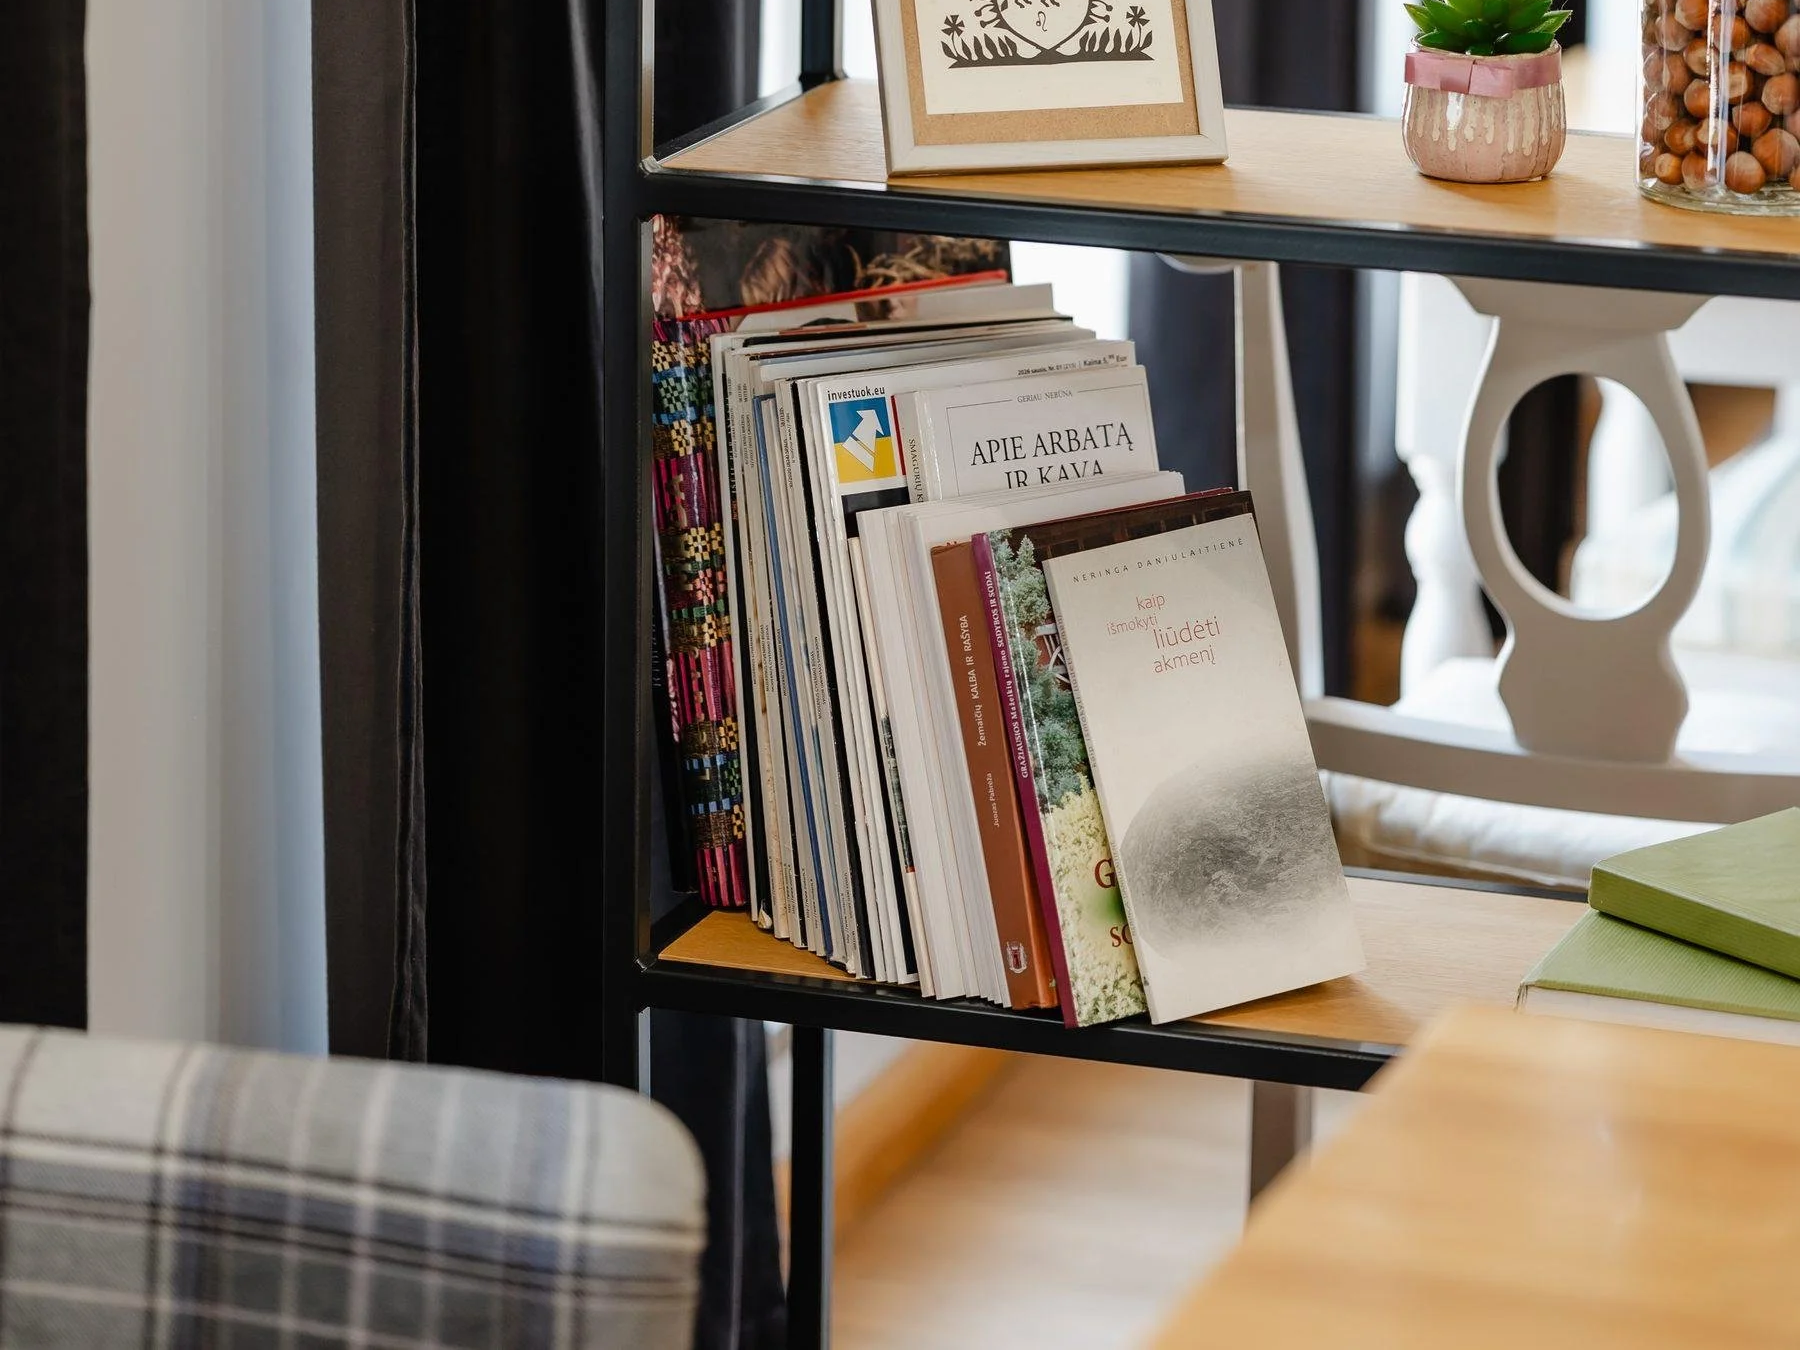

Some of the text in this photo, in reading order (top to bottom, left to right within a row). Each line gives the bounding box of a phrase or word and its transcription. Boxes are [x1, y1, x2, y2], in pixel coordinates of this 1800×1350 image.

[827, 386, 885, 401] investuok.eu
[970, 422, 1134, 466] APIE ARBATĄ
[1005, 469, 1028, 489] IR
[1073, 538, 1245, 583] NERINGA DANIULAITIENĖ
[985, 571, 995, 598] SODAI
[989, 598, 997, 607] IR
[1136, 593, 1166, 611] kaip
[991, 609, 1005, 647] SODYBOS
[1106, 613, 1159, 636] išmokyti
[1153, 615, 1221, 650] liūdėti
[1001, 650, 1010, 678] rajono
[1153, 645, 1217, 674] akmenį
[959, 615, 987, 747] Žemaičių KALBA IR RAŠYBA
[1013, 722, 1029, 779] GRAŽIAUSIOS
[991, 803, 999, 827] Juozas
